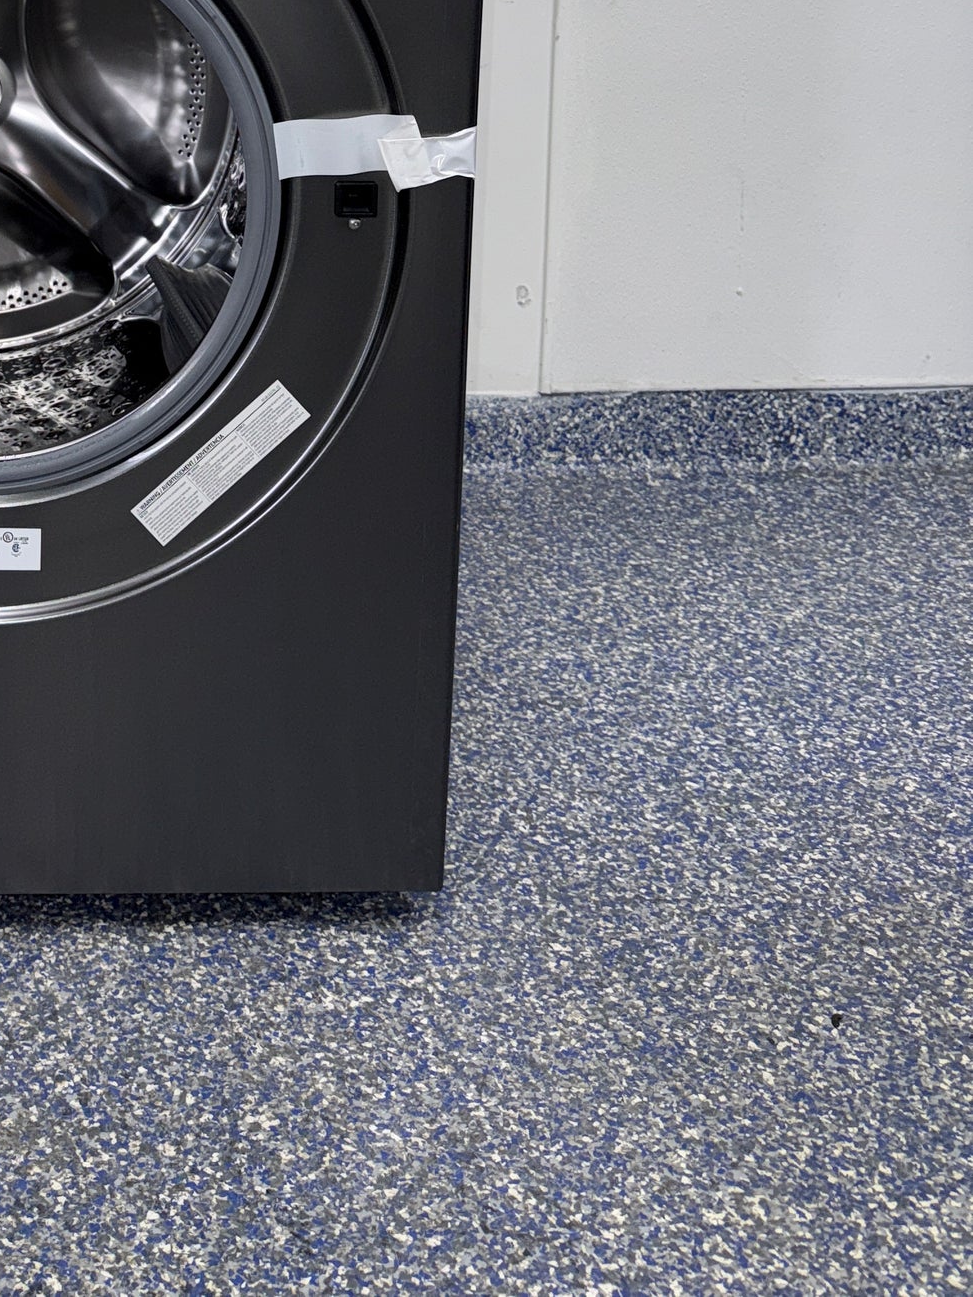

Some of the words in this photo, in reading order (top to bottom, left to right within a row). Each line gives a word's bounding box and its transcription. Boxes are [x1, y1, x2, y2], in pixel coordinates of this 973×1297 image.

[140, 491, 161, 511] WARNING
[162, 458, 195, 492] AVERTISSEMENT
[195, 434, 225, 460] ADVERTENCIA
